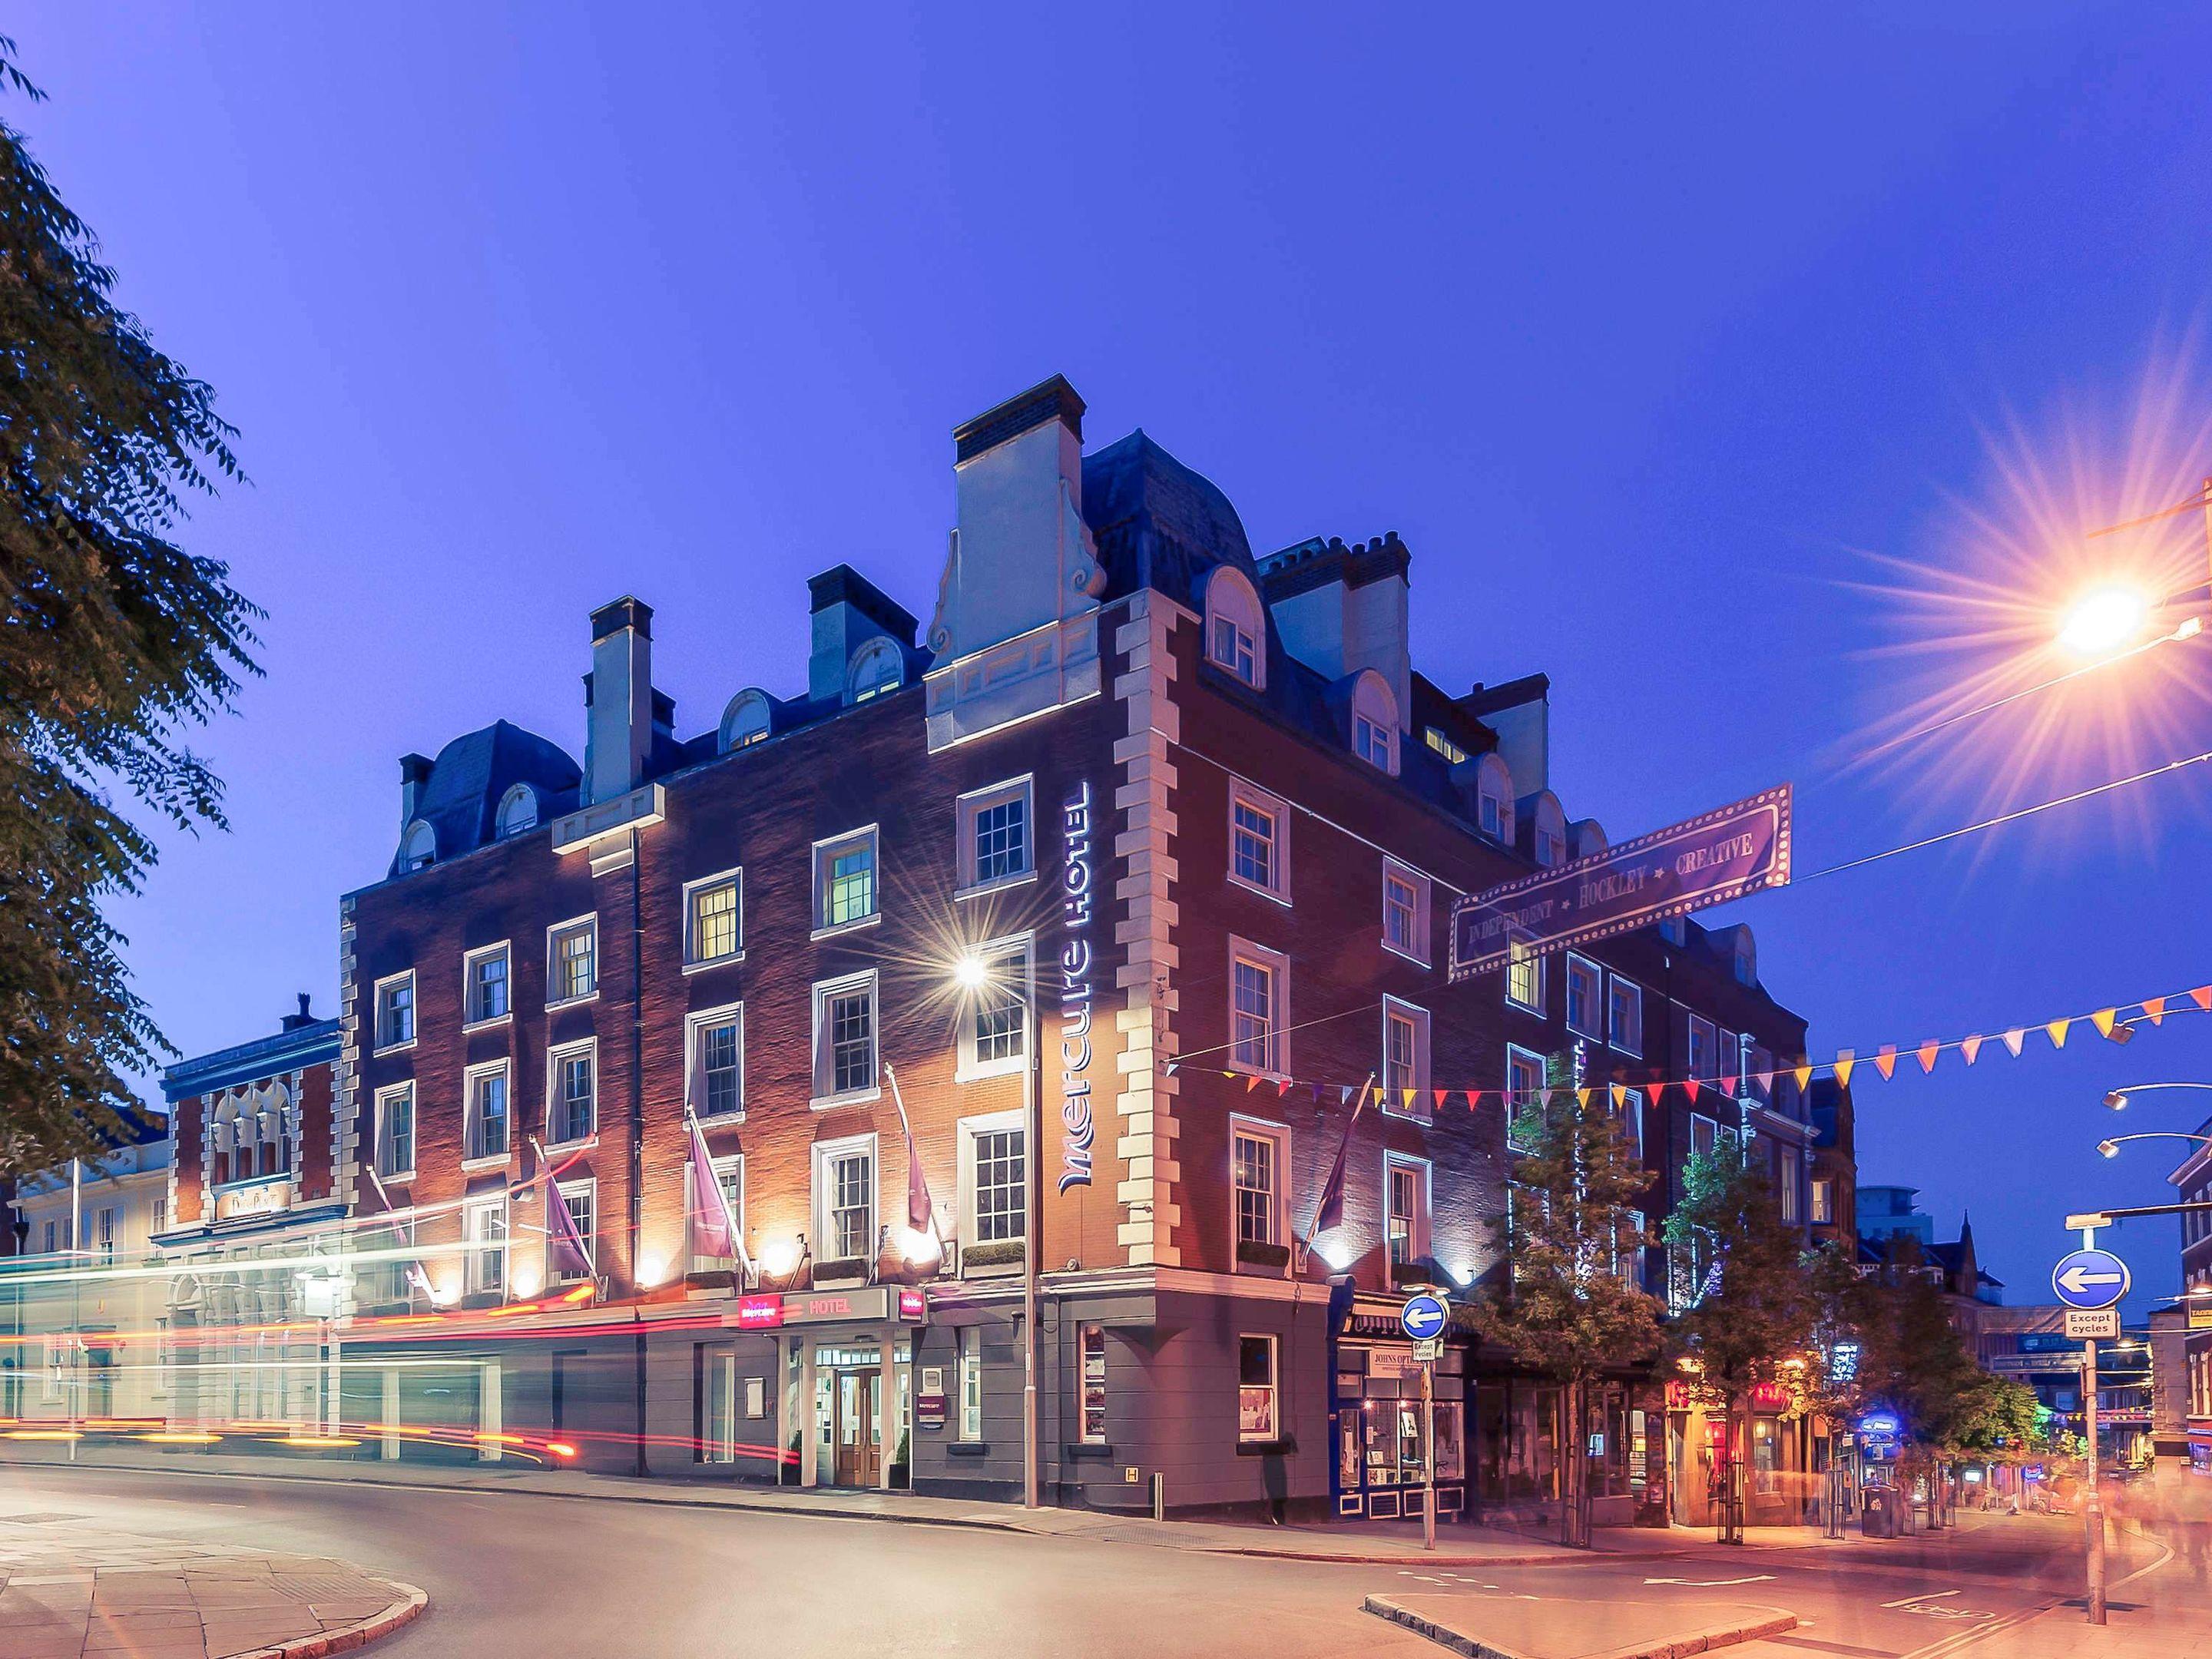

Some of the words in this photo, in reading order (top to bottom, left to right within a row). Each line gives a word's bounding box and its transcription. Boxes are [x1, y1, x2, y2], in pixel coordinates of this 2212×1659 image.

[1065, 780, 1090, 927] HOTEL
[1469, 899, 1553, 945] INDEPENDENT
[1578, 864, 1647, 909] HOCKLEY
[1676, 833, 1753, 875] CREATIVE
[810, 1298, 852, 1315] HOTEL
[2071, 1314, 2110, 1323] Except
[2072, 1324, 2108, 1333] cycles
[1375, 1354, 1396, 1363] JOHNS
